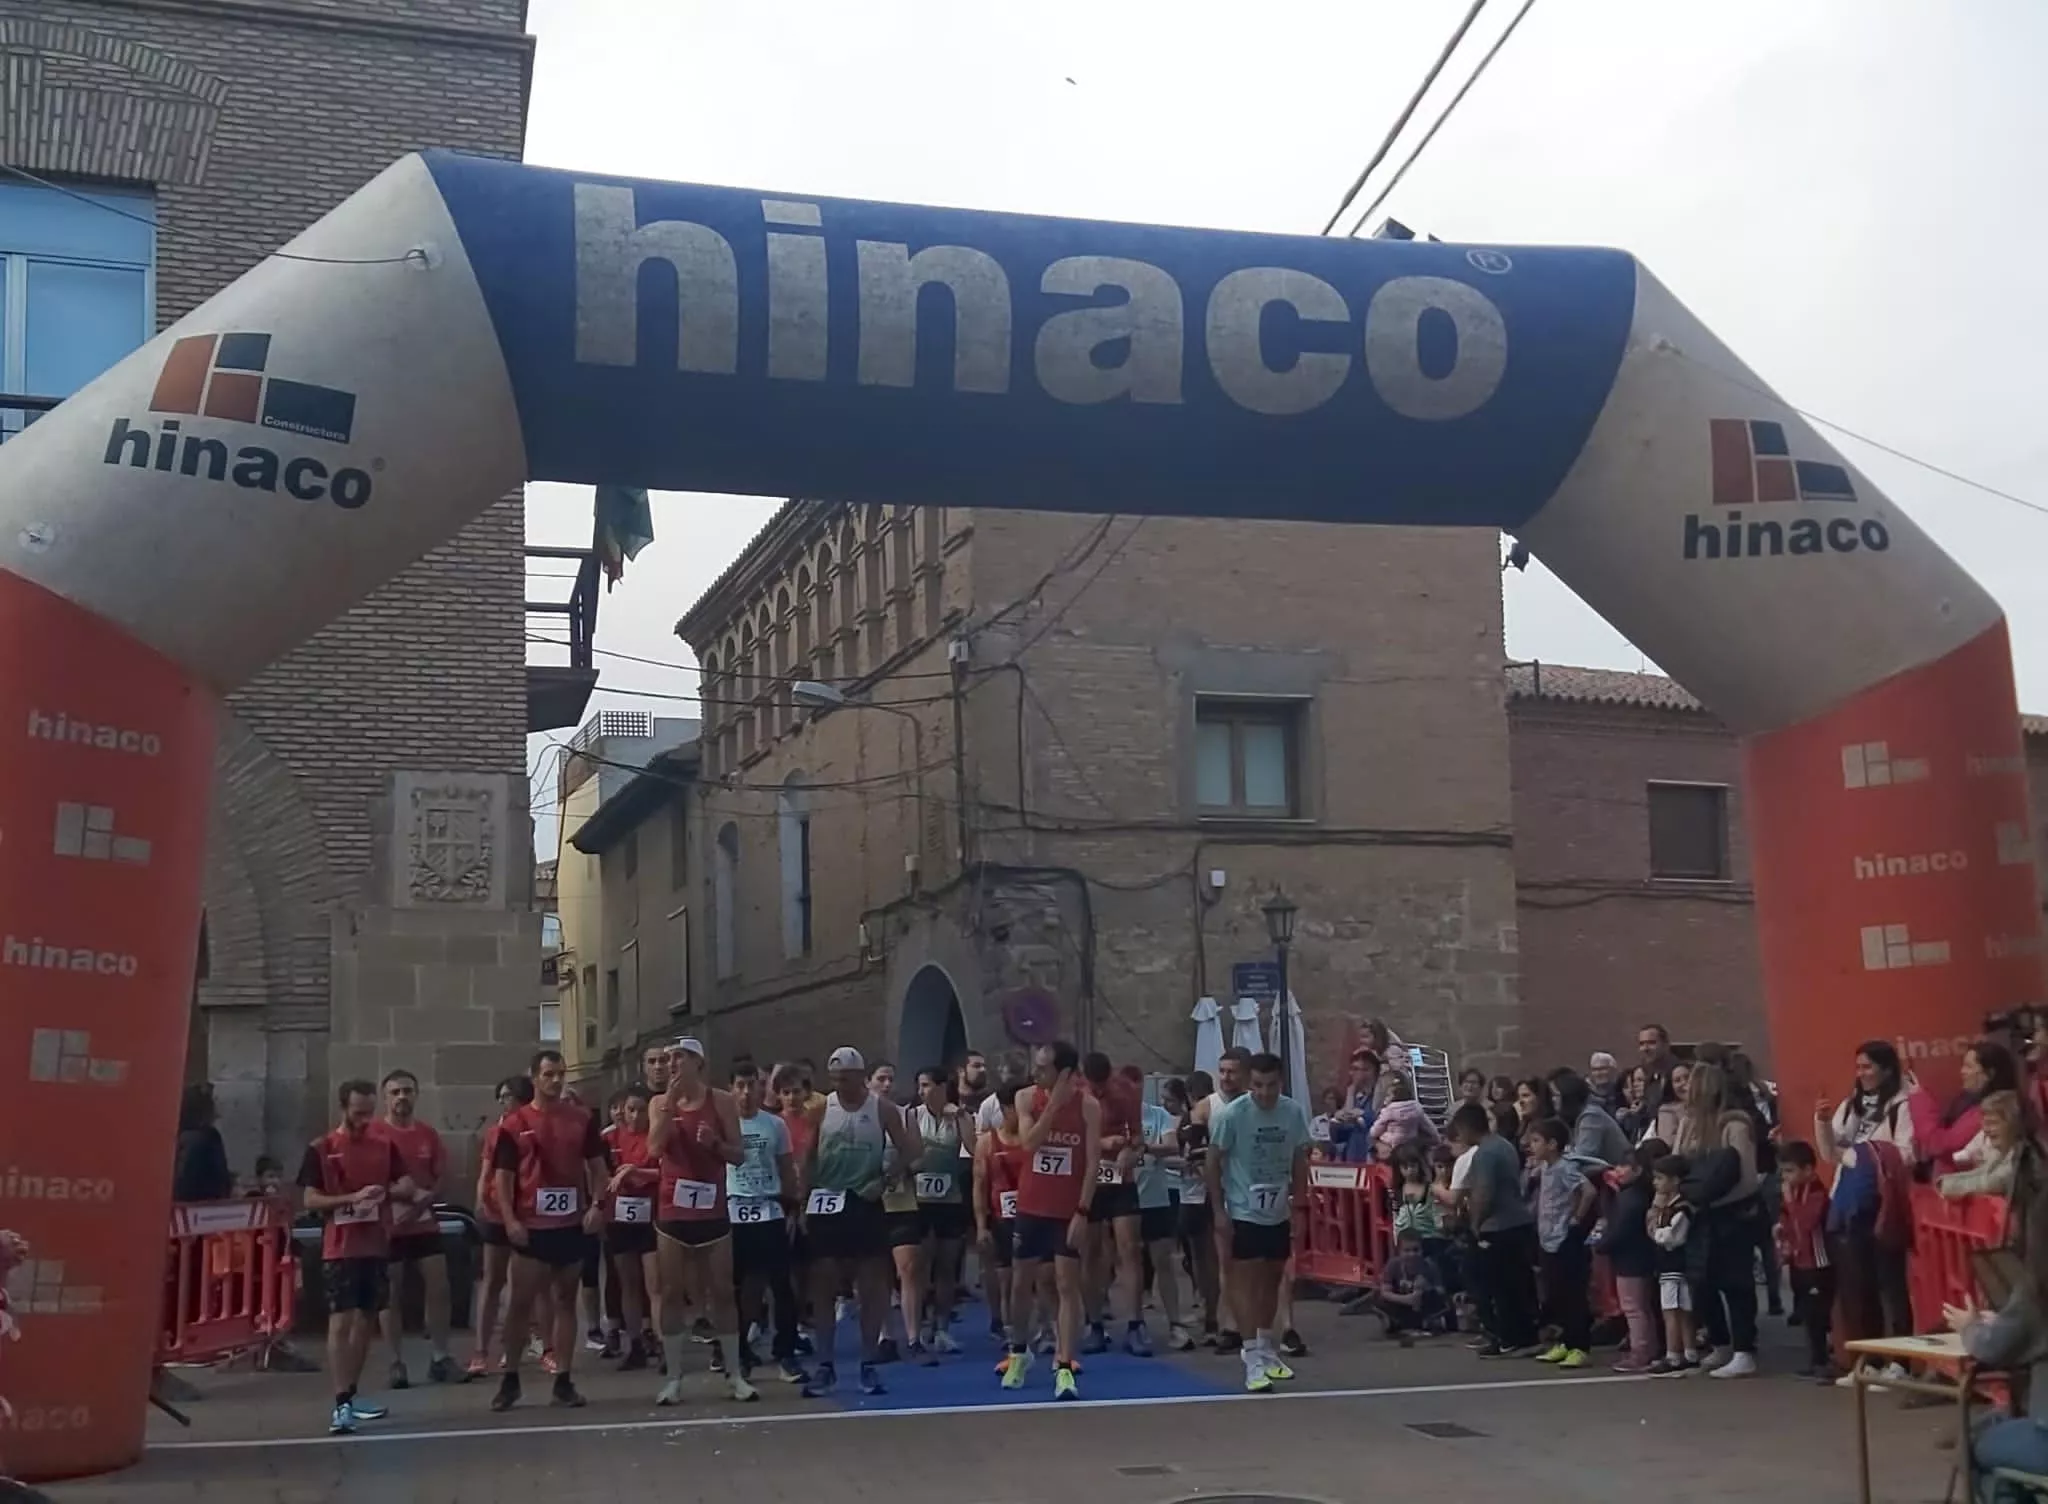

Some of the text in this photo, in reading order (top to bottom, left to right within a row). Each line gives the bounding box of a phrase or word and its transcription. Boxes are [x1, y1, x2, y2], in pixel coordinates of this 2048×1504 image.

[574, 182, 1508, 421] hinaco
[104, 418, 373, 509] hinaco
[1683, 511, 1890, 560] hinaco
[28, 709, 162, 757] hinaco
[1854, 850, 1969, 881] hinaco
[2, 933, 139, 978] hinaco
[1896, 1033, 1986, 1061] inac
[1041, 1156, 1065, 1173] 57
[0, 1164, 116, 1203] inaco
[544, 1193, 569, 1212] 28
[626, 1206, 638, 1222] 5
[689, 1192, 699, 1209] 1
[738, 1205, 761, 1222] 65
[815, 1196, 837, 1214] 15
[1256, 1191, 1278, 1209] 17
